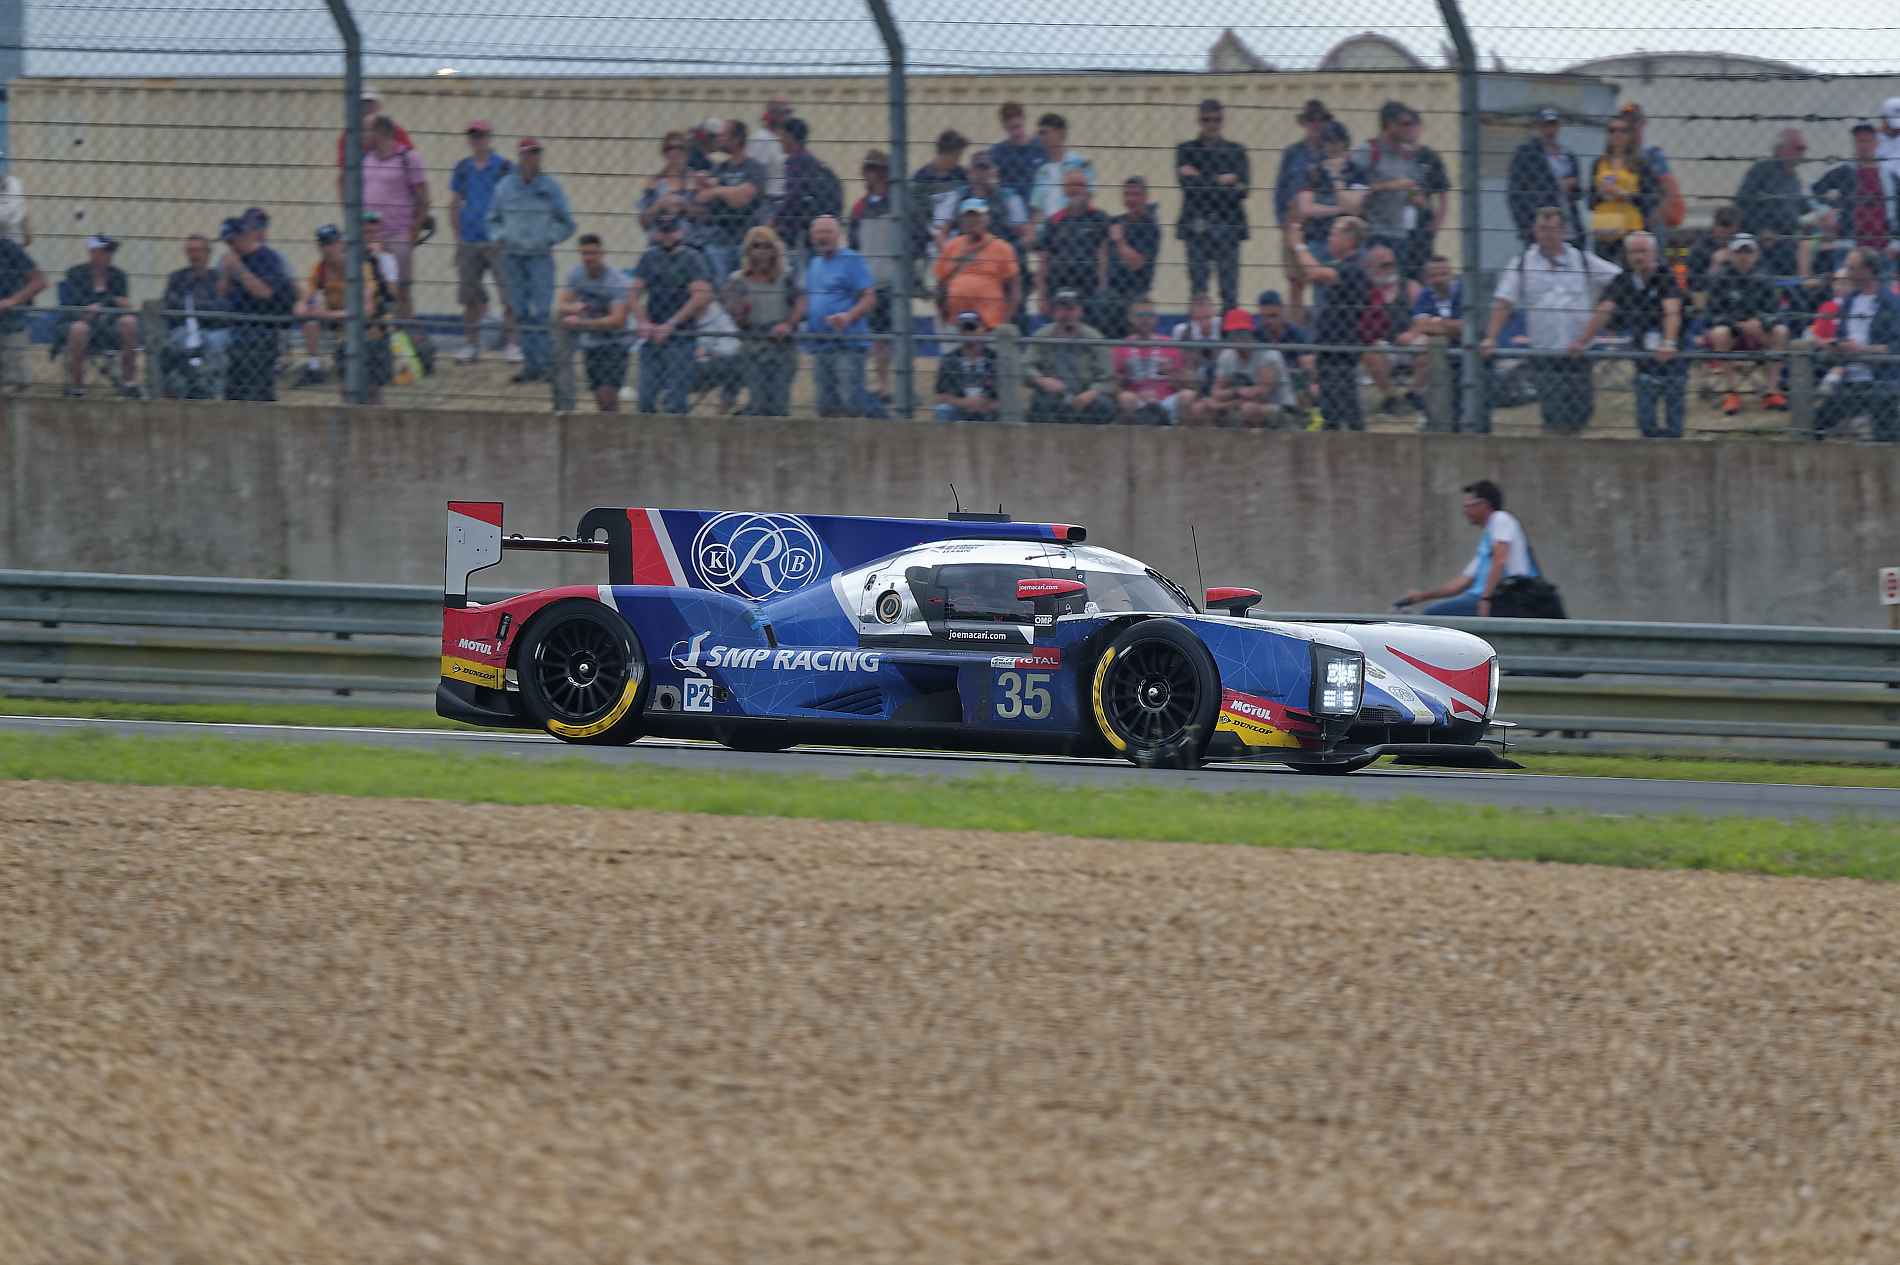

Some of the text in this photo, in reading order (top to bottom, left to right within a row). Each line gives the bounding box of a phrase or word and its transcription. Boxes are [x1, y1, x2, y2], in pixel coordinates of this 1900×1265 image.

[708, 550, 726, 569] K
[789, 555, 806, 572] B
[1018, 584, 1059, 592] joemacari.com
[1034, 616, 1053, 624] OMP
[949, 629, 1007, 641] joemacari.com
[458, 638, 492, 655] MOTUL
[705, 645, 882, 673] SMP RACING
[462, 667, 496, 680] DUNLOP
[686, 683, 711, 708] P2
[996, 671, 1052, 720] 35
[1230, 699, 1272, 721] MOTUL
[1232, 719, 1273, 735] DUNLOP
